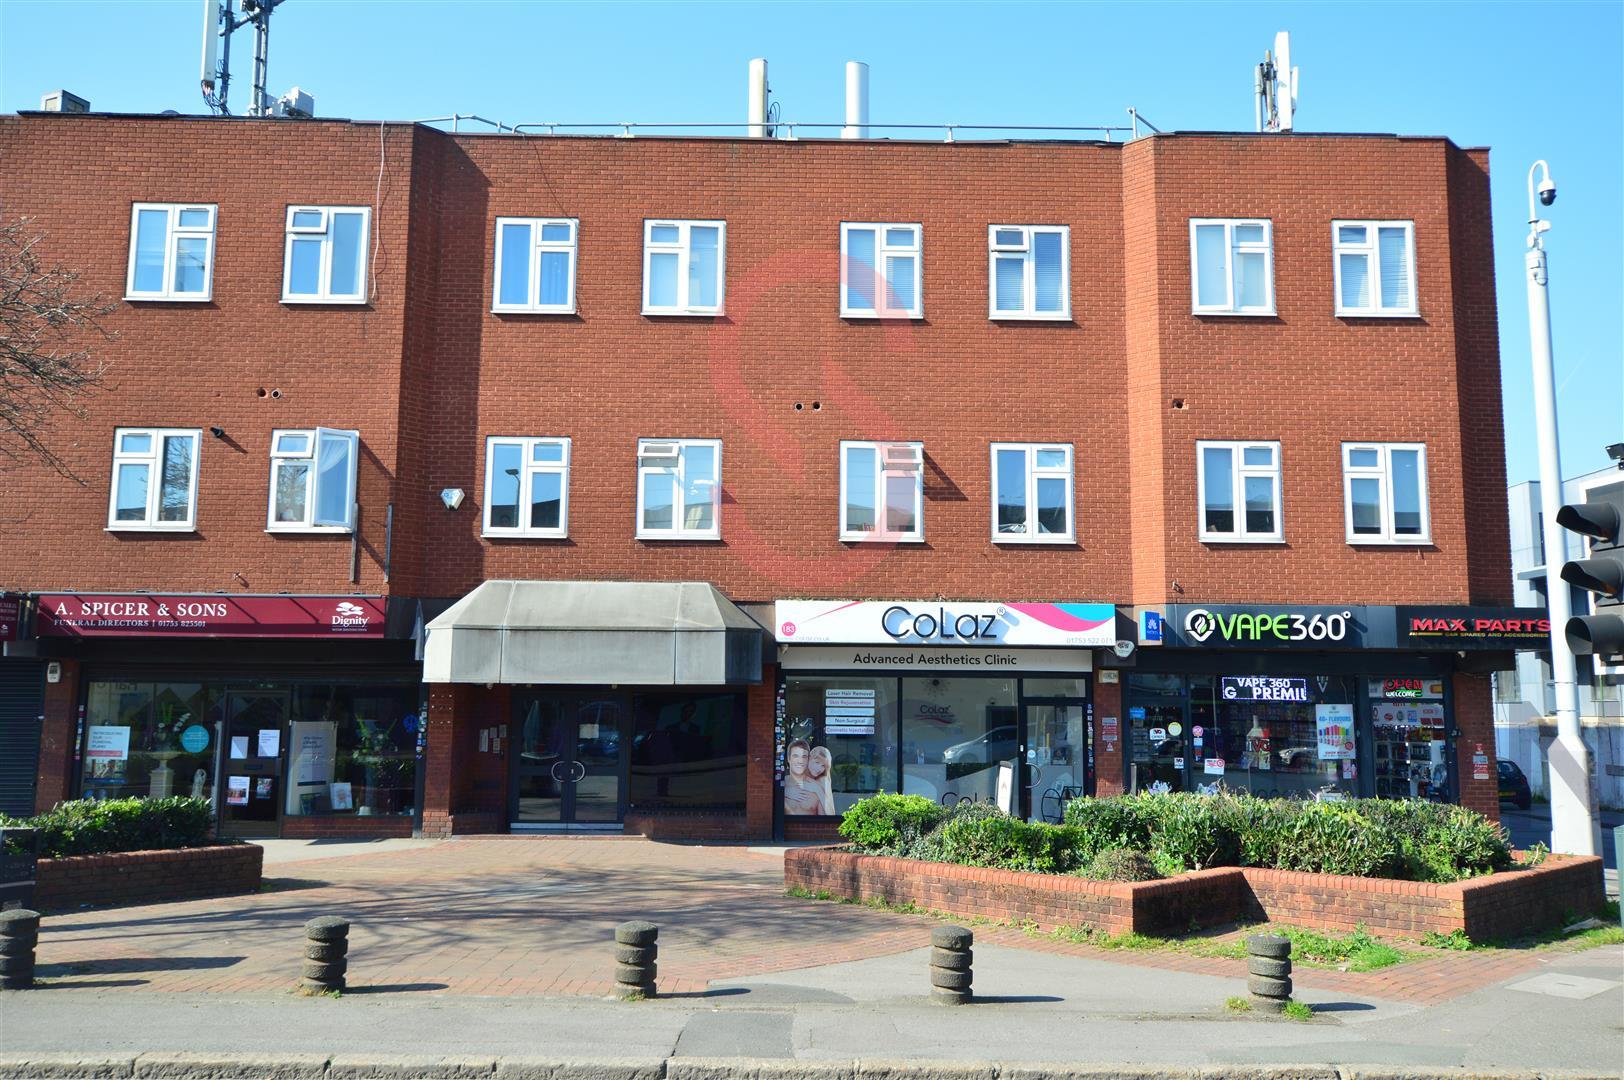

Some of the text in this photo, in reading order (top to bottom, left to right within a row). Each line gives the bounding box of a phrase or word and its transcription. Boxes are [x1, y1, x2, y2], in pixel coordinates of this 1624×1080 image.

[55, 602, 227, 617] A. SPICER & SONS
[54, 619, 96, 627] FUNERAL
[98, 619, 149, 628] DIRECTORS
[158, 620, 178, 628] 01753
[332, 615, 368, 627] Dignity
[1412, 618, 1551, 632] MAX PARTS
[784, 625, 795, 633] 183
[853, 653, 1017, 665] Advanced Aesthetics Clinic
[1237, 678, 1291, 688] VAPE 360
[1384, 679, 1423, 690] OPEN
